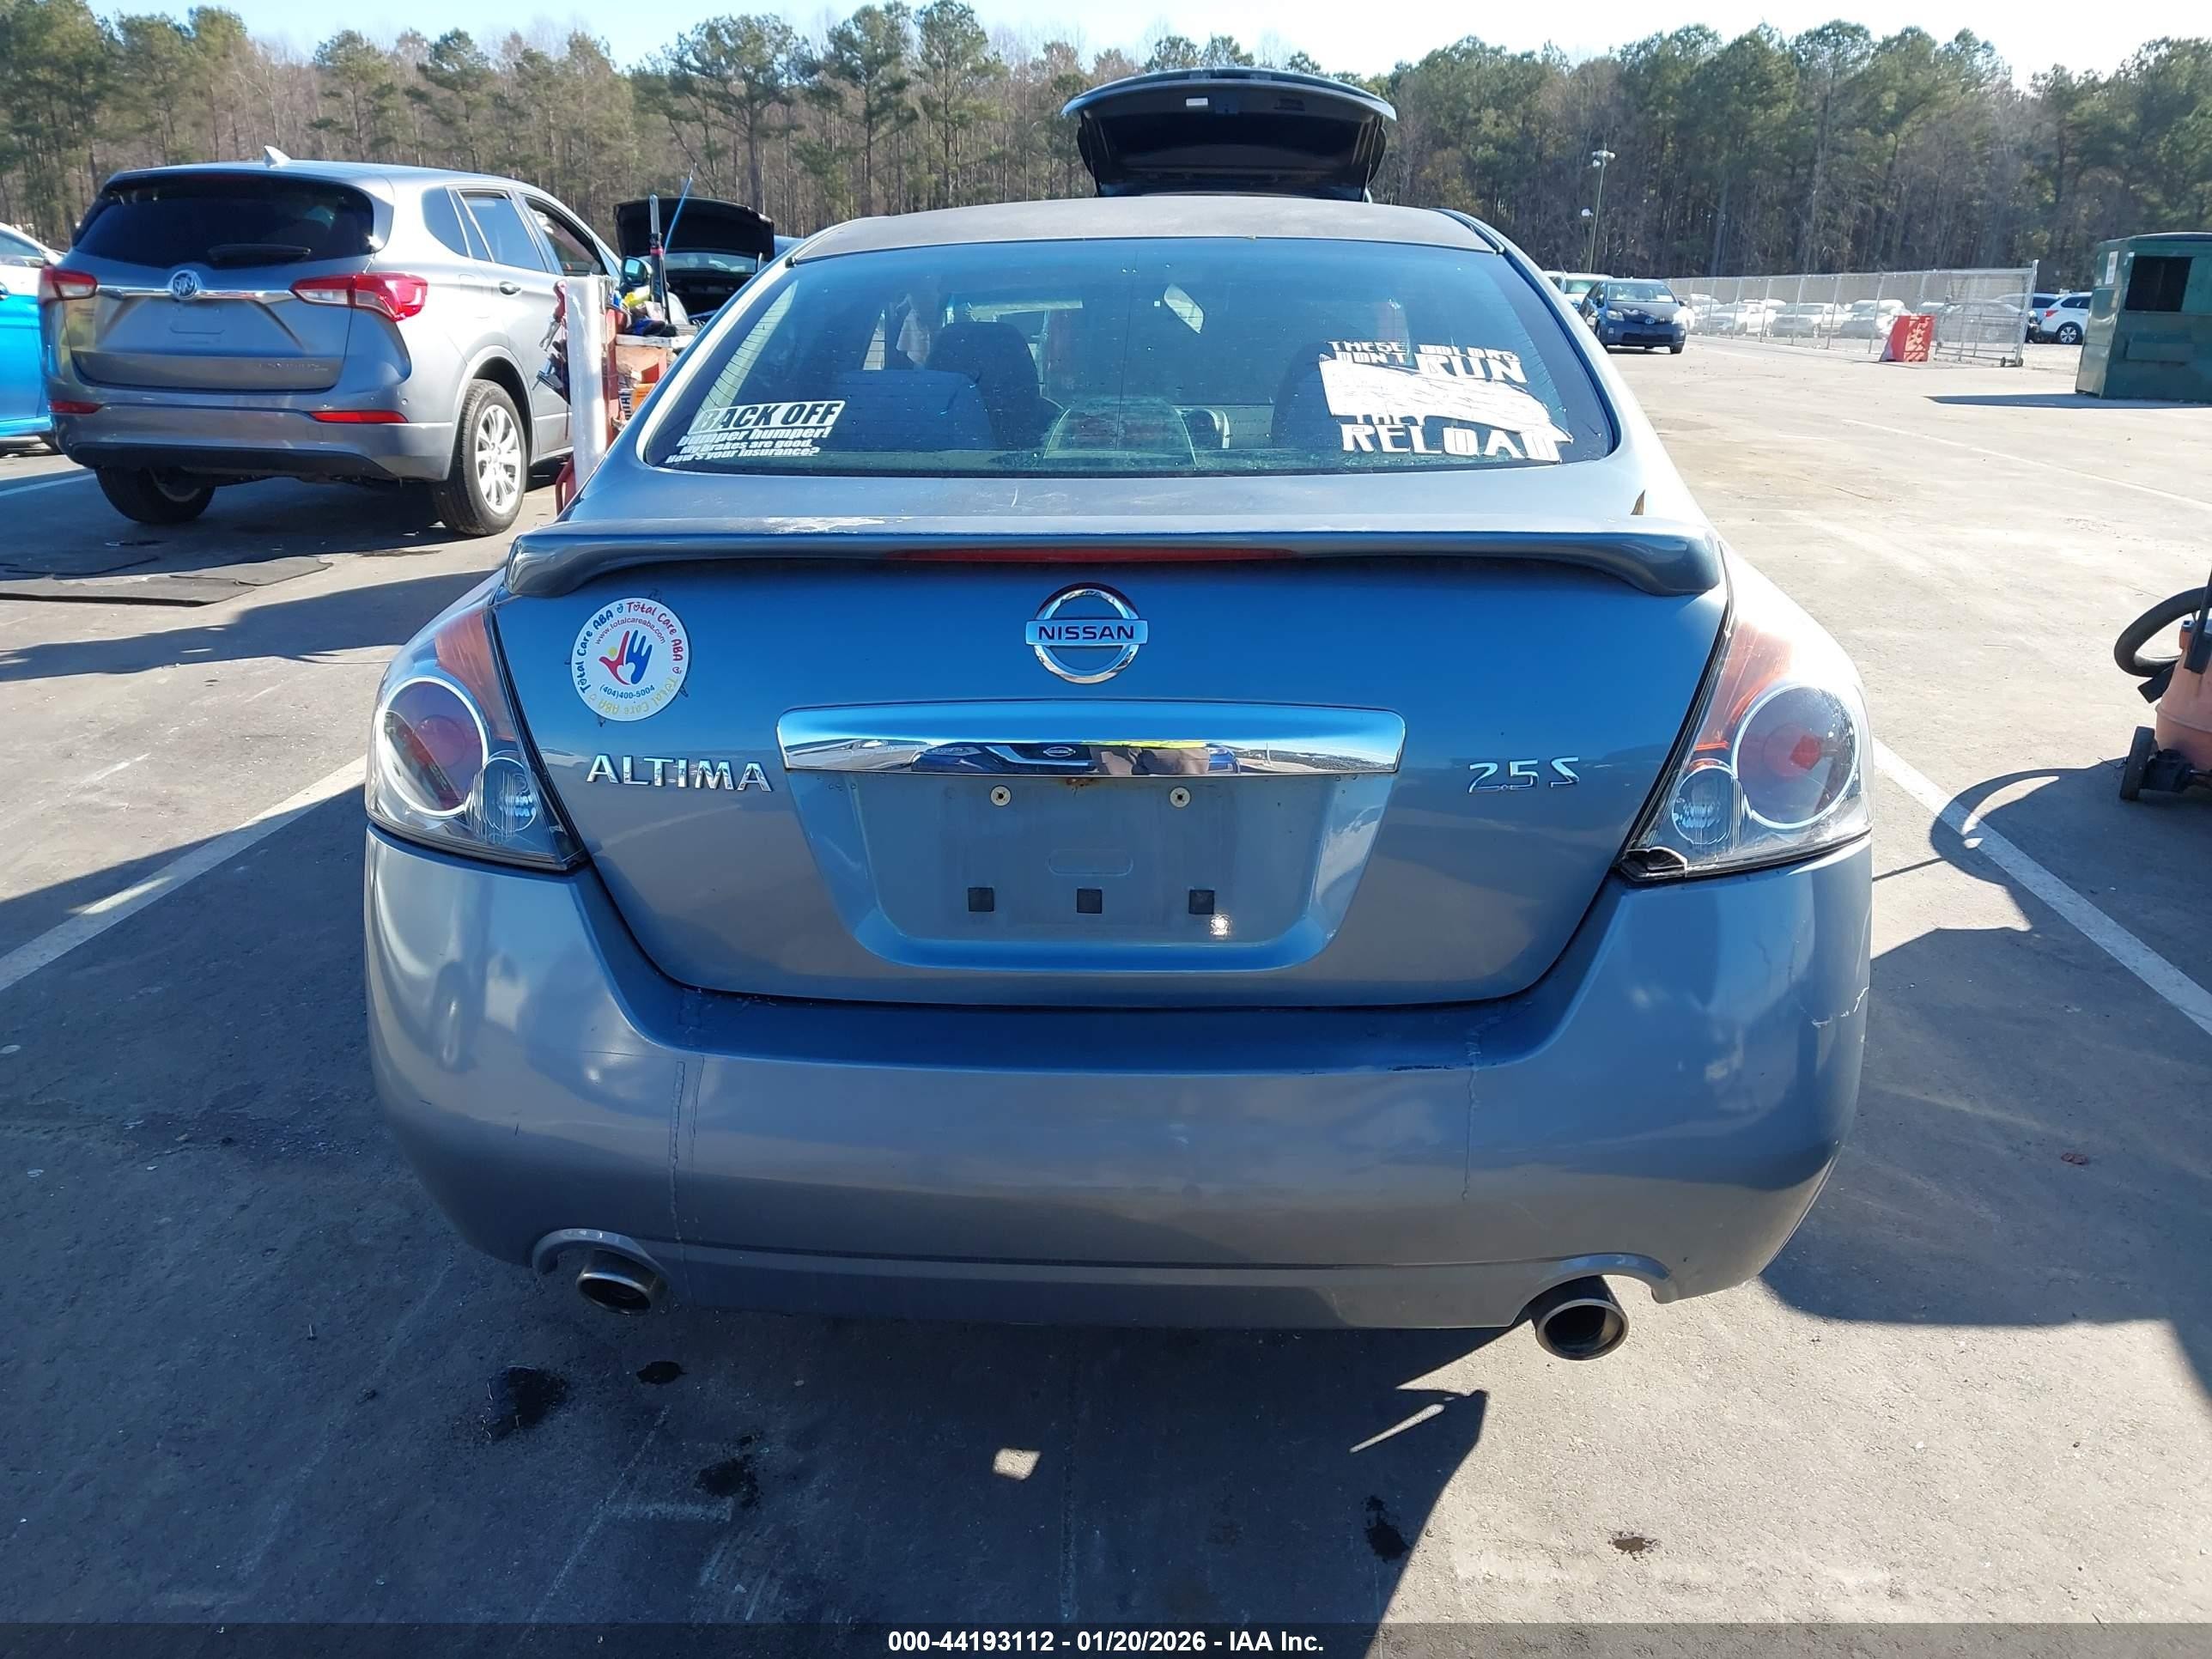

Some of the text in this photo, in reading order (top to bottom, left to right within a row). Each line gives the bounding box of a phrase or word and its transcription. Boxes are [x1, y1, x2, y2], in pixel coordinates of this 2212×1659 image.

[1326, 341, 1407, 352] THESE
[1414, 353, 1527, 384] RUN
[696, 403, 840, 431] BACK OFF
[679, 445, 701, 454] My
[700, 441, 748, 452] brakes
[775, 439, 812, 449] good.
[748, 427, 833, 440] humper!
[1340, 422, 1562, 462] RELOAD
[704, 450, 739, 459] your
[738, 447, 821, 457] insurance?
[595, 617, 666, 645] www.totalcareaba.com
[627, 601, 684, 661] Total Care ABA
[1038, 625, 1134, 641] NISSAN
[575, 610, 613, 694] Total Care ABA
[599, 684, 655, 700] (404)400-5004
[586, 753, 773, 793] ALTIMA
[1549, 756, 1580, 788] S
